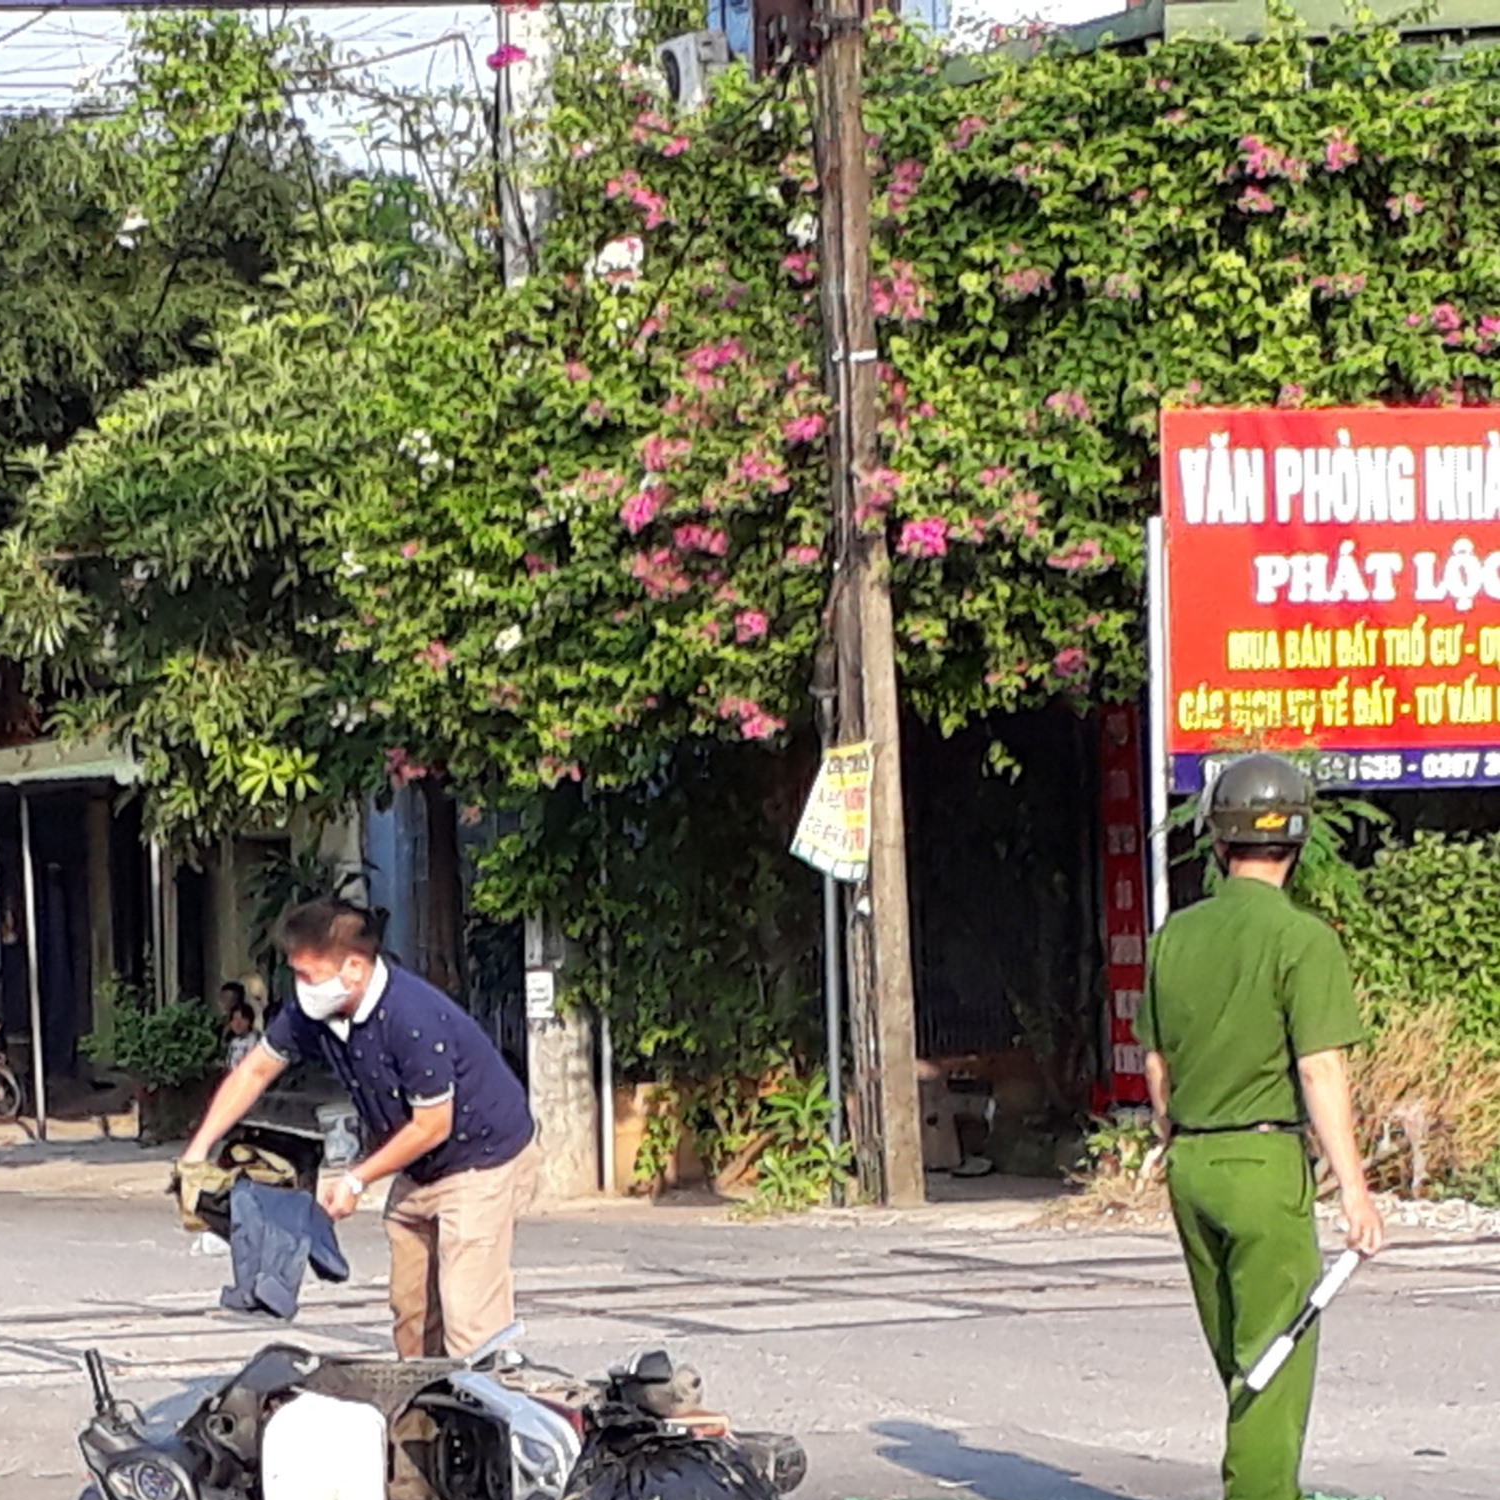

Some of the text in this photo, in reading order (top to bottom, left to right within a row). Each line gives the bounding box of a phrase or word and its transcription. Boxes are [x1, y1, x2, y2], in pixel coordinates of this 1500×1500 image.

[1180, 431, 1264, 523] VĂN
[1274, 428, 1415, 523] PHÒNG
[1254, 539, 1403, 603] PHÁT
[1227, 630, 1280, 669] MUA
[1285, 622, 1331, 668] BÁN
[1335, 616, 1379, 667] ĐẤT
[1430, 623, 1464, 666] CƯ
[1352, 675, 1396, 725] ĐẤT
[1447, 672, 1492, 722] VẤN
